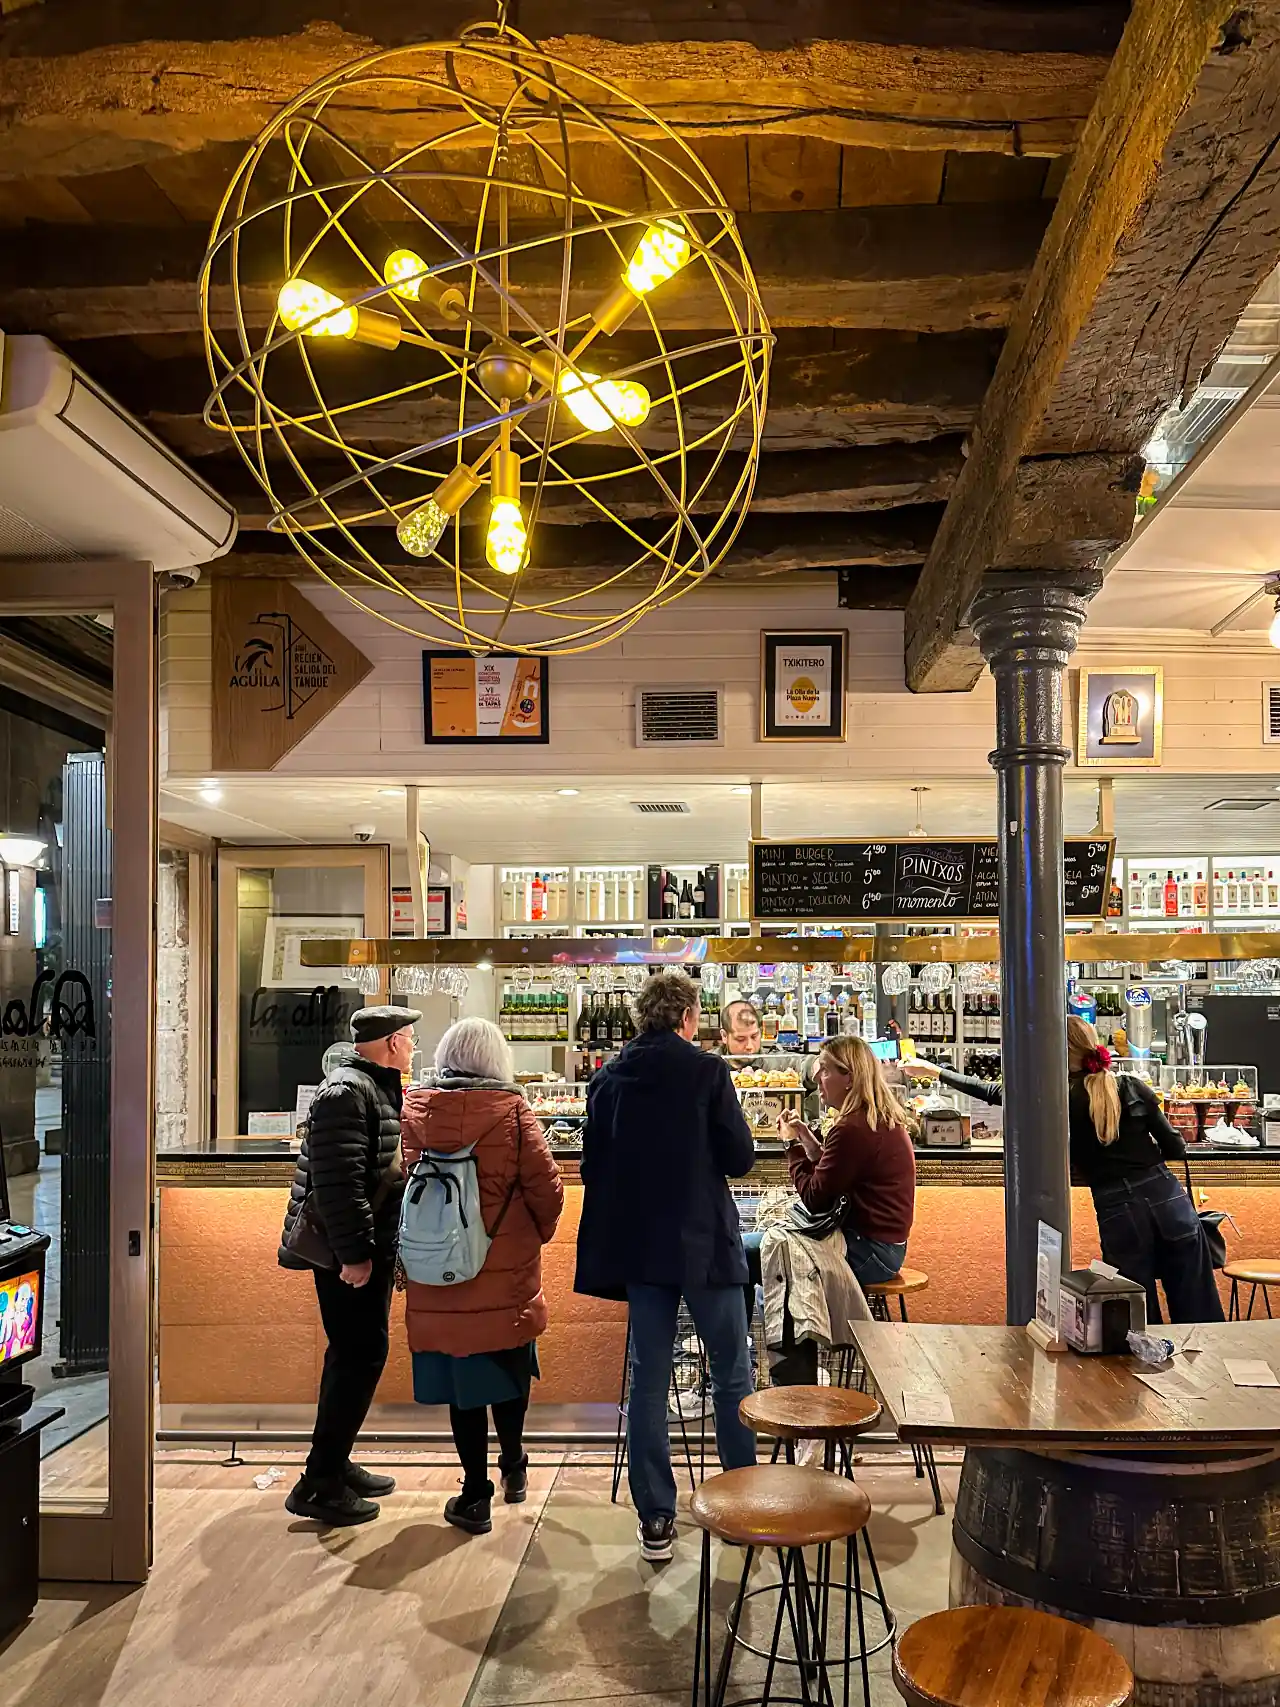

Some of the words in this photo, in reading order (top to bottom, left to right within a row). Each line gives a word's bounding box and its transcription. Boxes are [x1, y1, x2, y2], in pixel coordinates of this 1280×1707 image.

[783, 658, 825, 667] TXIKITERO
[294, 664, 320, 675] SALIDA
[322, 664, 338, 675] DEL
[229, 675, 280, 688] AGUILA
[294, 676, 329, 688] TANQUE
[761, 848, 785, 860] MINI
[795, 847, 834, 861] BURGER
[902, 857, 964, 882] PINTXOS
[761, 872, 799, 886] PINTXO
[811, 871, 852, 885] SECRETO
[904, 879, 916, 889] AL
[761, 896, 795, 908] PINTXO
[896, 886, 965, 909] momento
[974, 890, 998, 902] ATÚN
